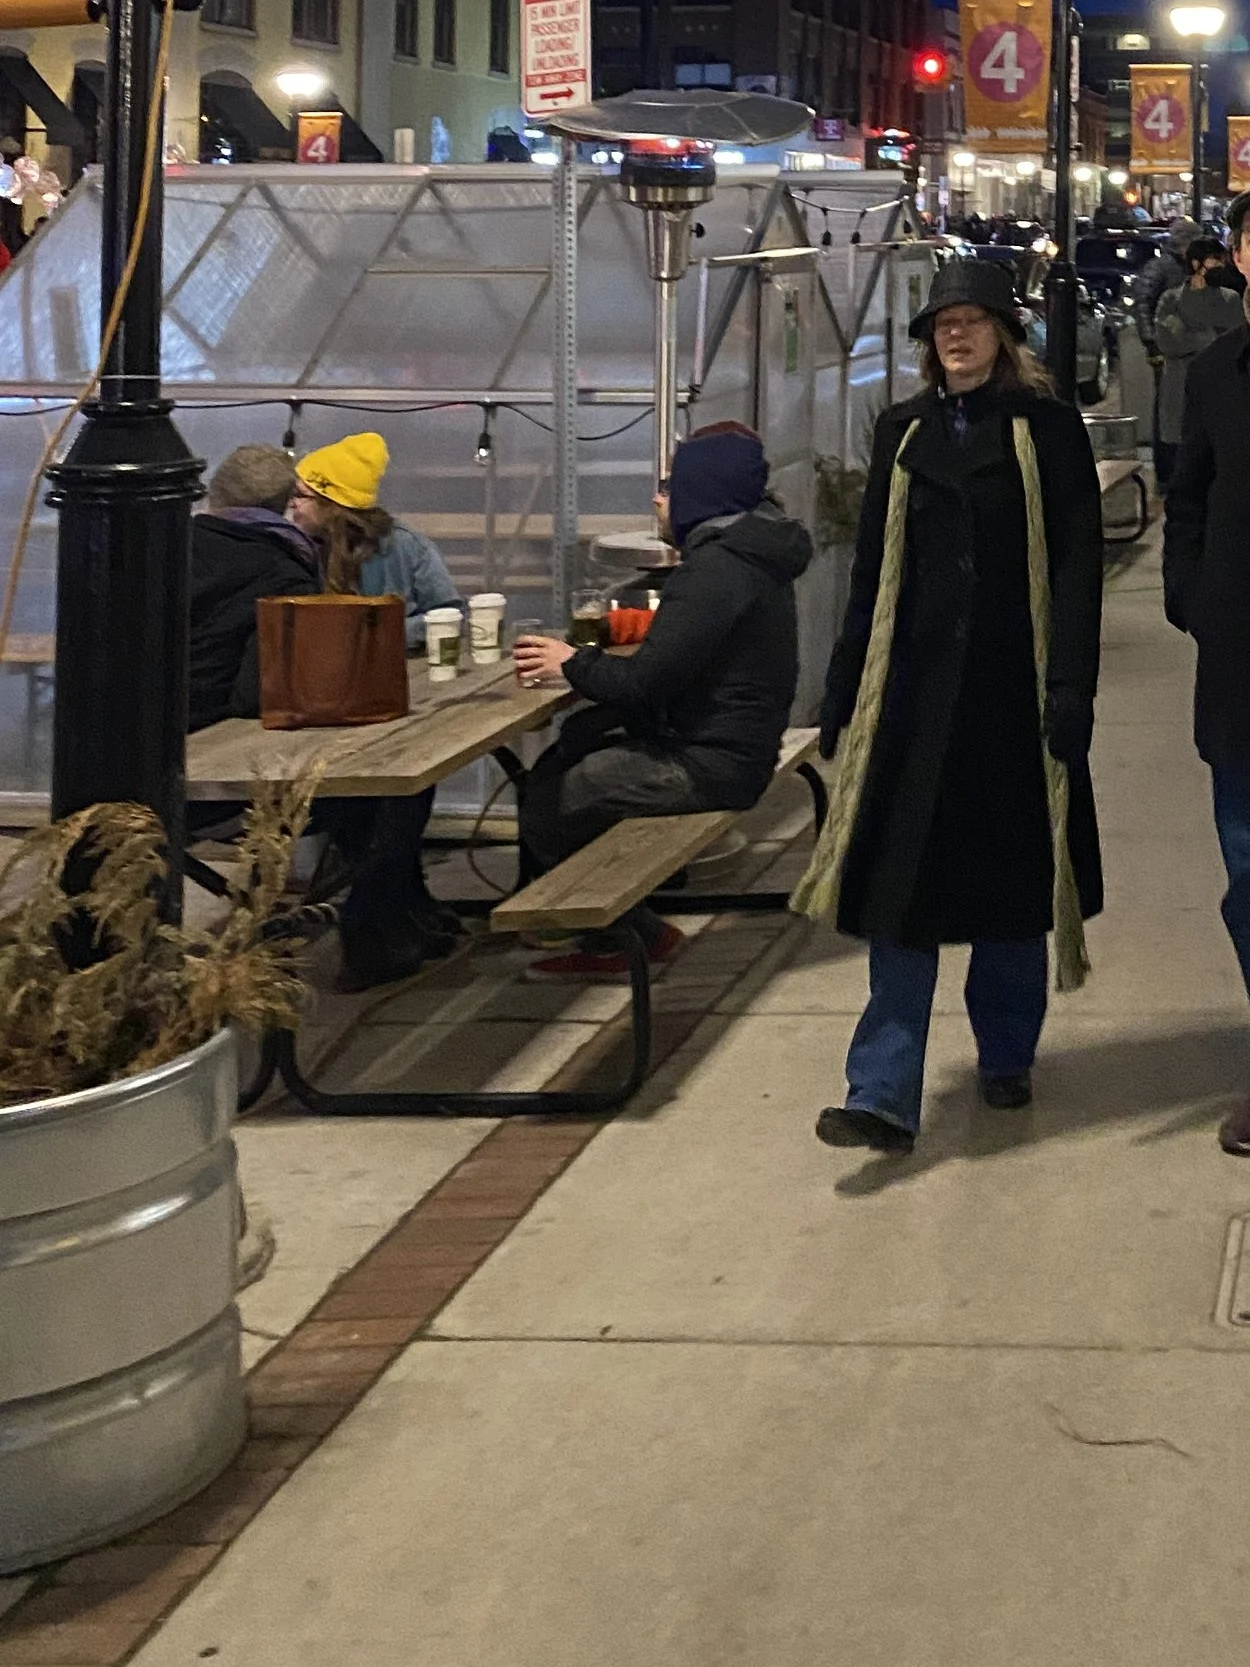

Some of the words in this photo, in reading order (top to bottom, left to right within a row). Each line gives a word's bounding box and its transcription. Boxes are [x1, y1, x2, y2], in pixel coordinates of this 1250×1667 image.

[531, 18, 580, 36] PASSENGER
[980, 30, 1025, 93] 4
[1143, 99, 1174, 138] 4
[307, 135, 328, 163] 4
